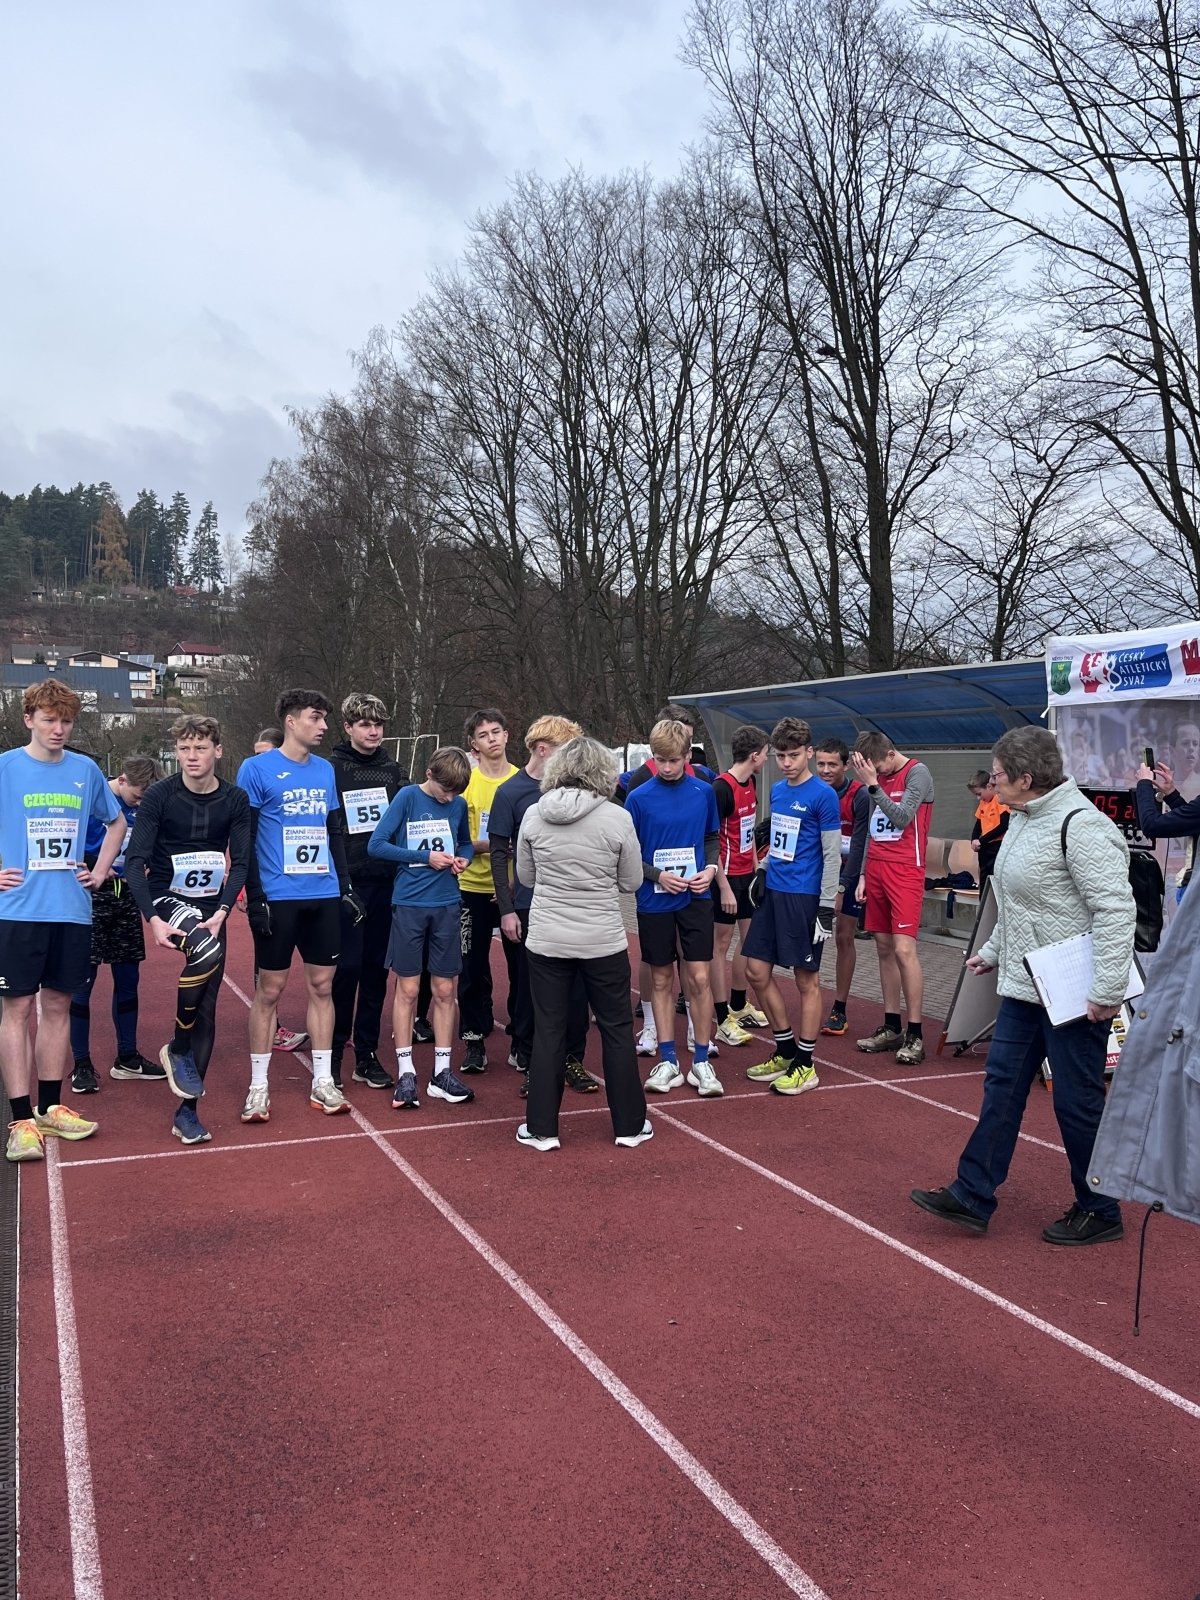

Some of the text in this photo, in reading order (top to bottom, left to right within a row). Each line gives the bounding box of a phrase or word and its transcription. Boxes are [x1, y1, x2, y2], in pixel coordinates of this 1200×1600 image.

[1119, 649, 1145, 663] ČESKÝ
[1120, 658, 1167, 675] ATLETICKÝ
[1123, 675, 1145, 687] SVAZ
[357, 805, 381, 823] 55
[876, 817, 896, 833] 54
[36, 838, 72, 859] 157
[416, 837, 445, 852] 48
[774, 831, 788, 850] 51
[296, 845, 320, 864] 67
[184, 870, 213, 888] 63
